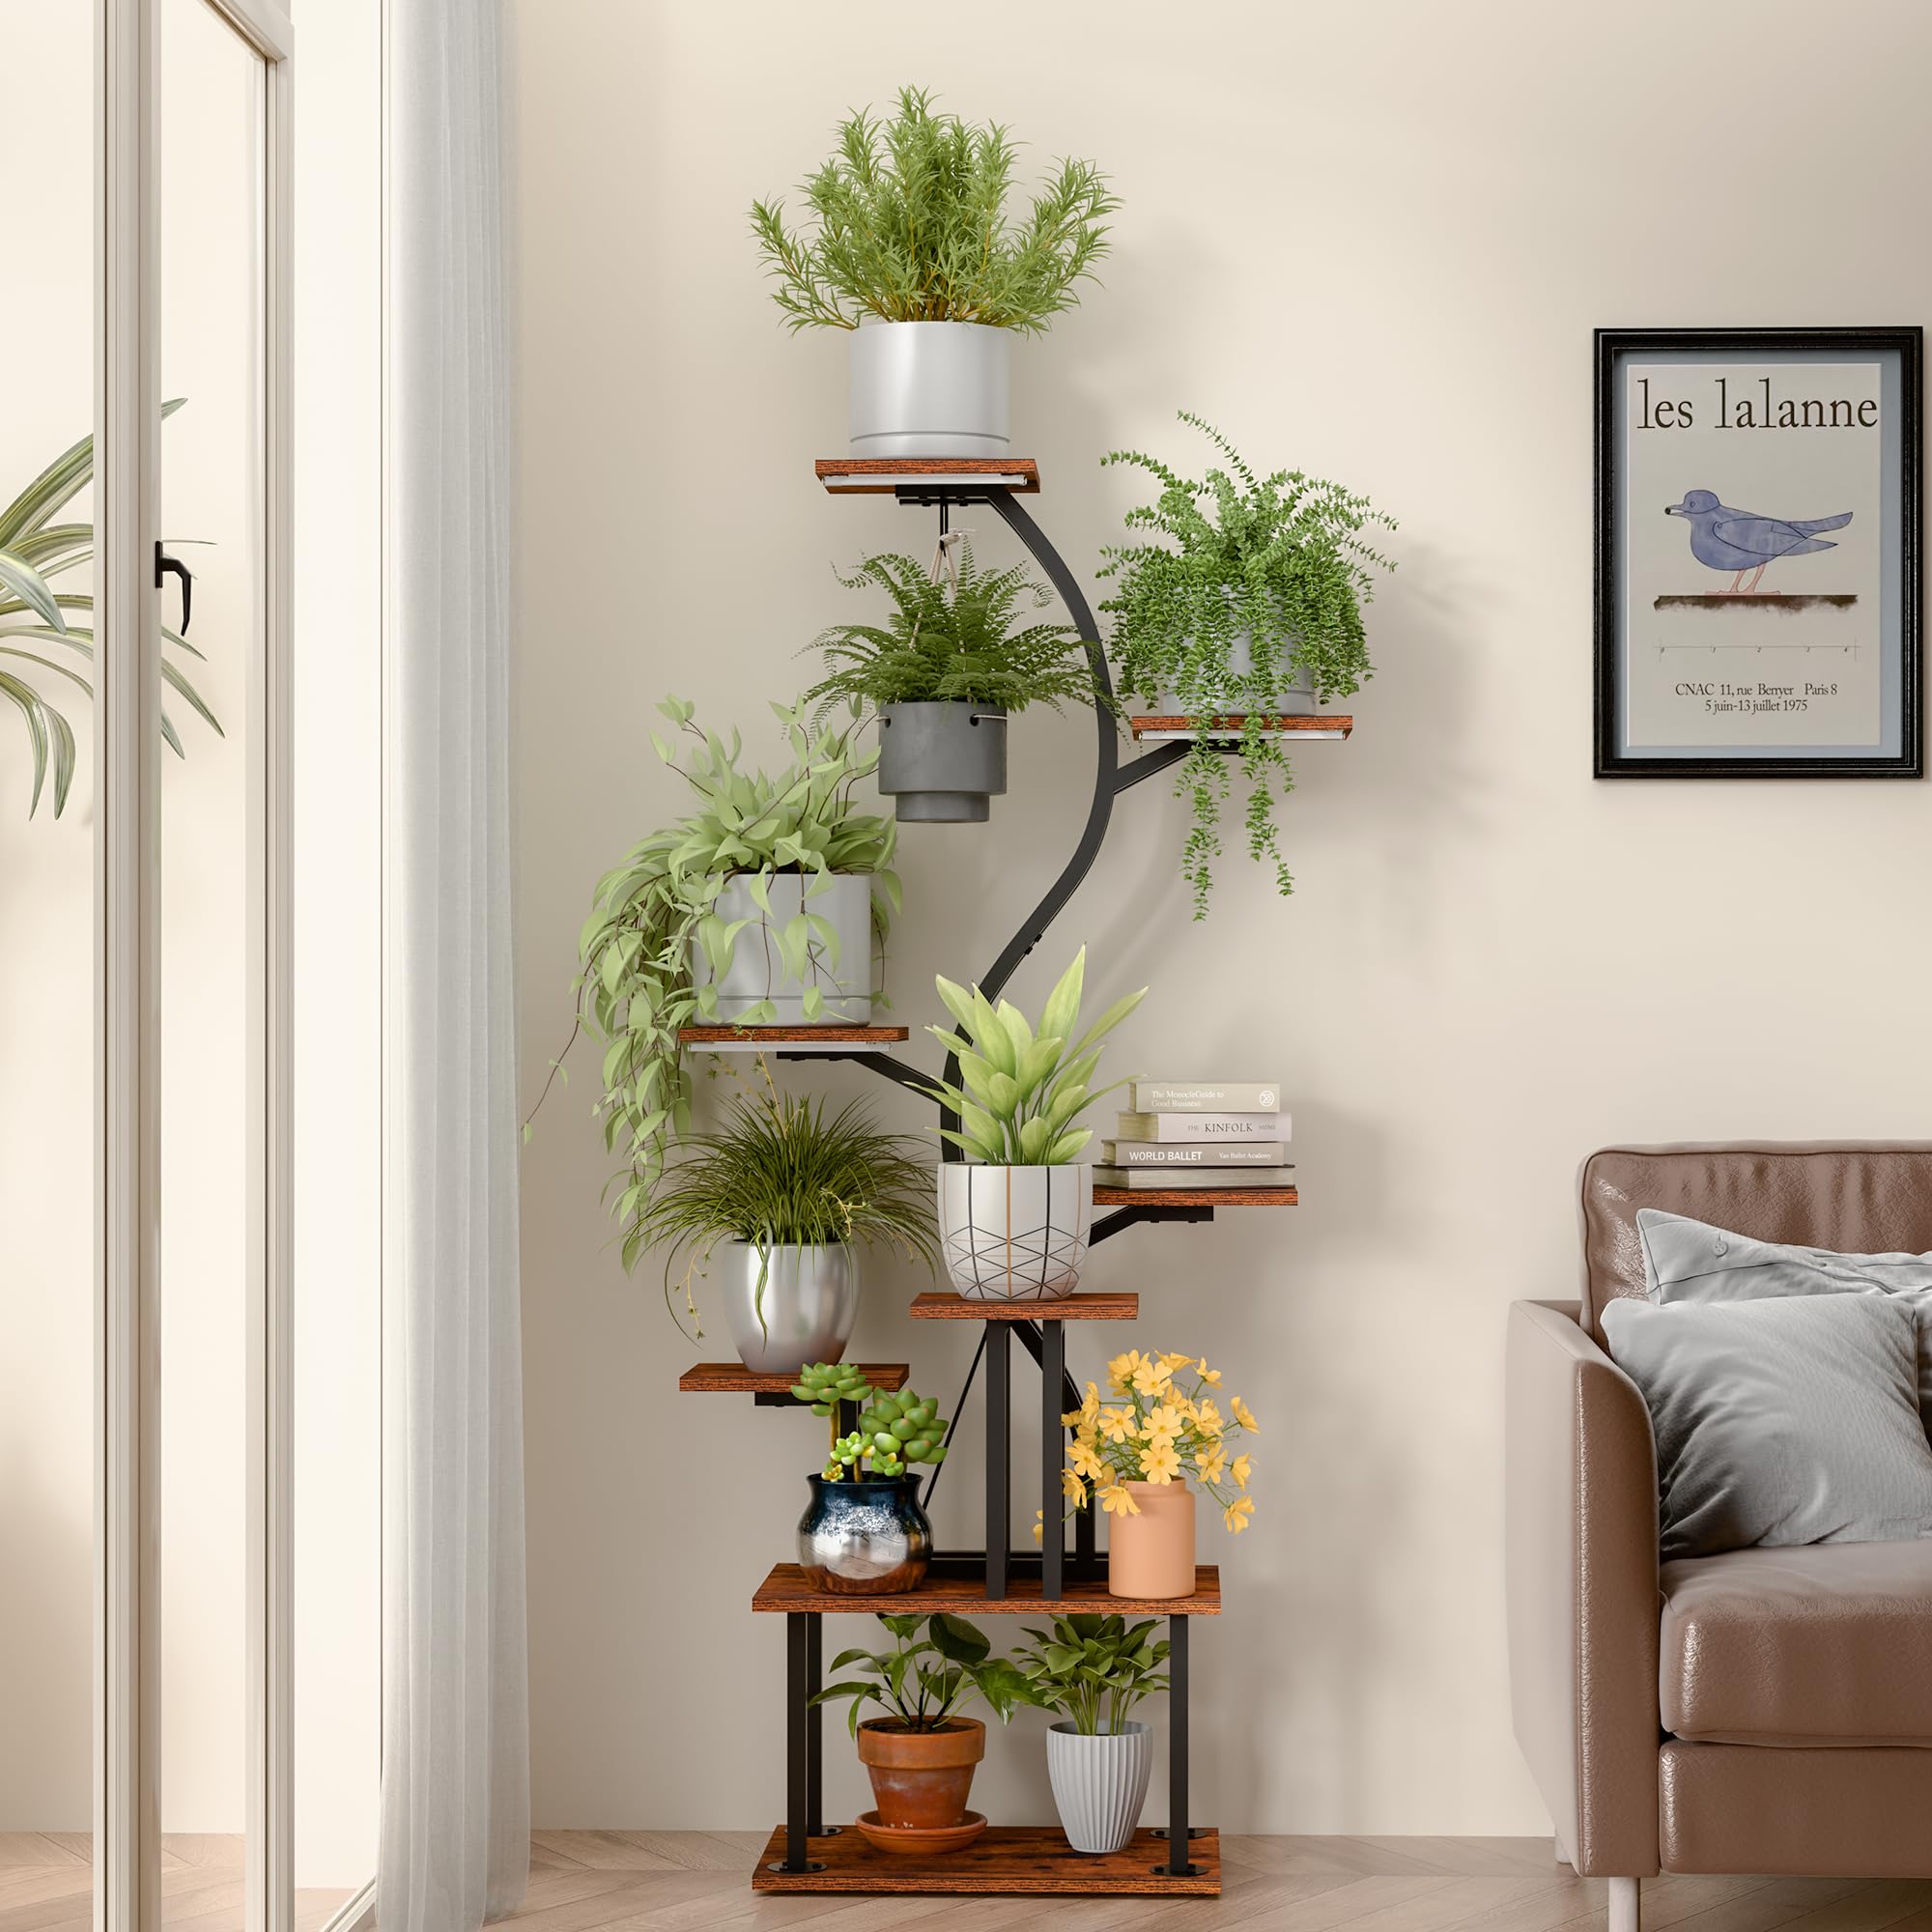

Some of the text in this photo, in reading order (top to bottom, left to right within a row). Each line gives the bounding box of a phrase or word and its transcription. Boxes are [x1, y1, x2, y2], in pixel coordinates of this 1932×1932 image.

[1636, 377, 1878, 429] les lalanne
[1675, 683, 1715, 696] CNAC
[1719, 683, 1735, 697] 11,
[1737, 687, 1753, 696] rue
[1804, 682, 1830, 696] Paris
[1831, 683, 1838, 696] 8
[1704, 699, 1712, 712] 5
[1751, 698, 1781, 716] juillet
[1783, 699, 1808, 712] 1975
[1151, 1090, 1165, 1098] The
[1216, 1090, 1225, 1098] to
[1205, 1122, 1253, 1132] KINFOLK
[1128, 1151, 1165, 1161] WORLD
[1167, 1151, 1203, 1161] BALLET
[1247, 1151, 1272, 1160] Academy
